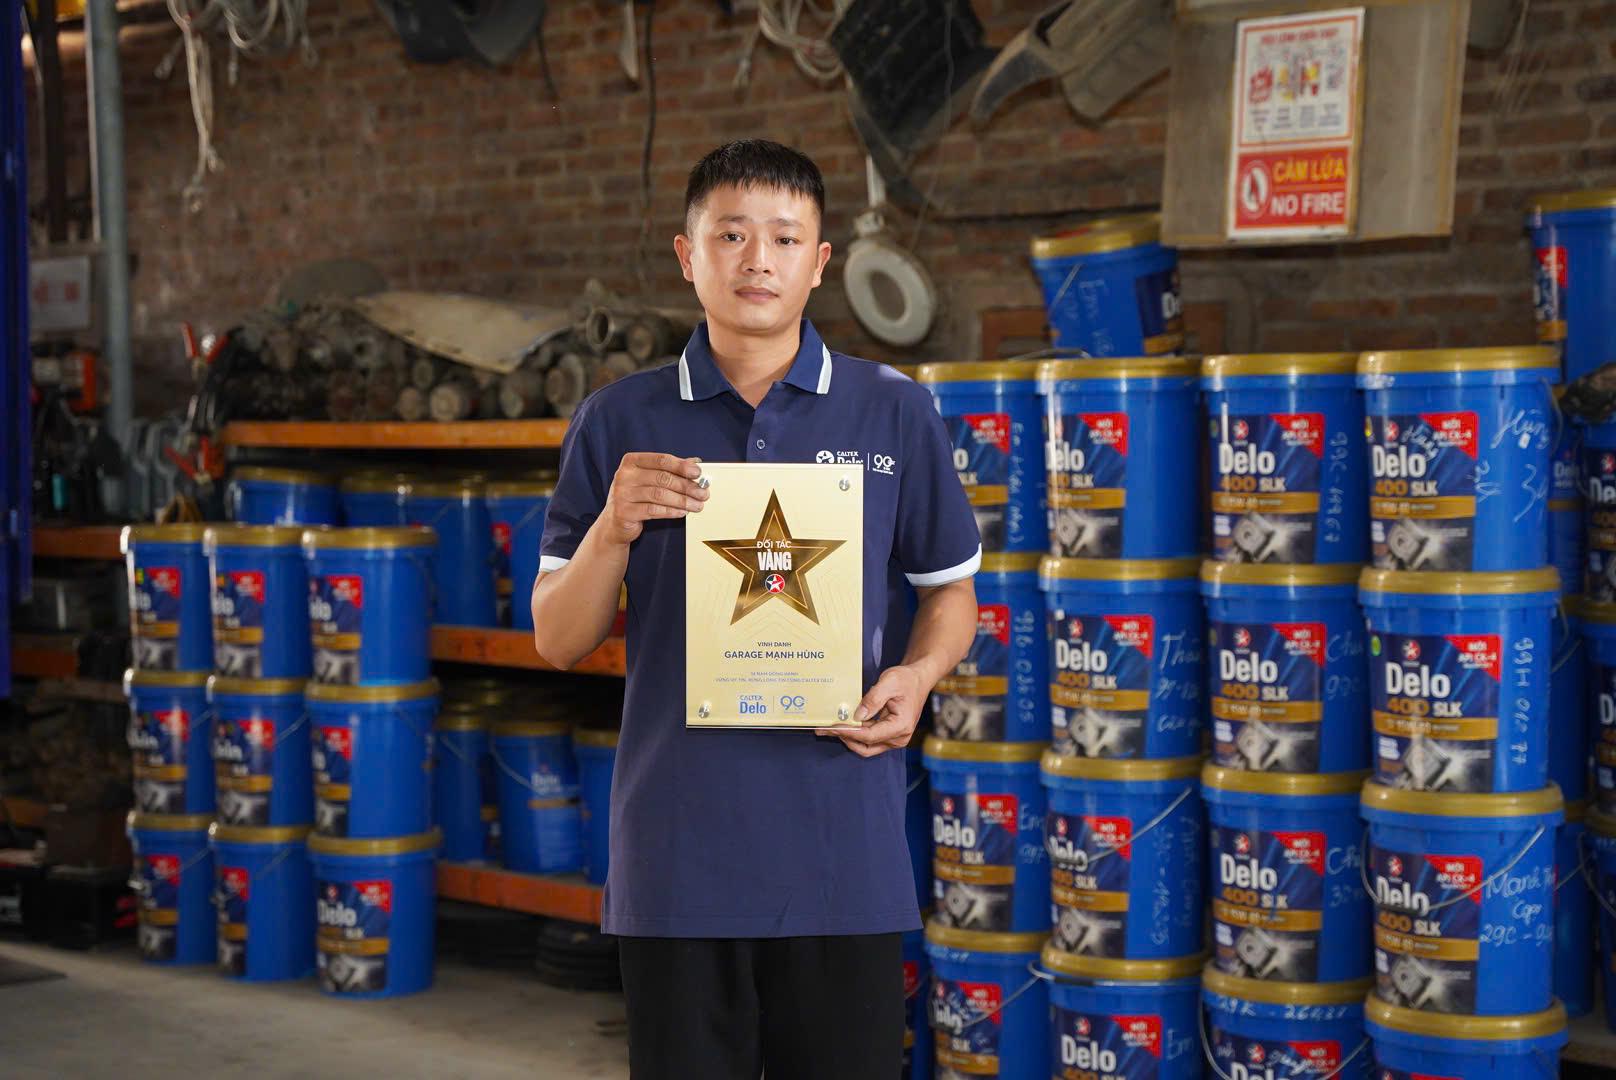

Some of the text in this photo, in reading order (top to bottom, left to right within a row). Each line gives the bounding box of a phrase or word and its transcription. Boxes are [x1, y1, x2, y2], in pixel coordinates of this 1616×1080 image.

[1271, 191, 1345, 217] NO FIRE
[1219, 443, 1275, 474] Delo
[1373, 445, 1426, 478] Delo
[1071, 472, 1094, 488] SLK
[1259, 477, 1286, 492] SLK
[1376, 480, 1438, 497] 400 SLK
[756, 539, 792, 548] ĐỐI TÁC
[757, 549, 792, 571] VÀNG
[724, 649, 824, 661] GARAGE MẠNH HÙNG
[1056, 638, 1108, 672] Delo
[1220, 649, 1278, 683] Delo
[1092, 674, 1117, 690] SLK
[1386, 662, 1450, 698] Delo
[1222, 682, 1289, 700] 400 SLK
[740, 702, 766, 714] Delo
[1387, 698, 1462, 718] 400 SLK
[934, 814, 976, 848] Delo
[962, 850, 984, 865] SLK
[1075, 874, 1097, 890] SLK
[1220, 853, 1278, 890] Delo
[1379, 910, 1441, 936] 400 SLK
[1061, 1034, 1117, 1072] Delo
